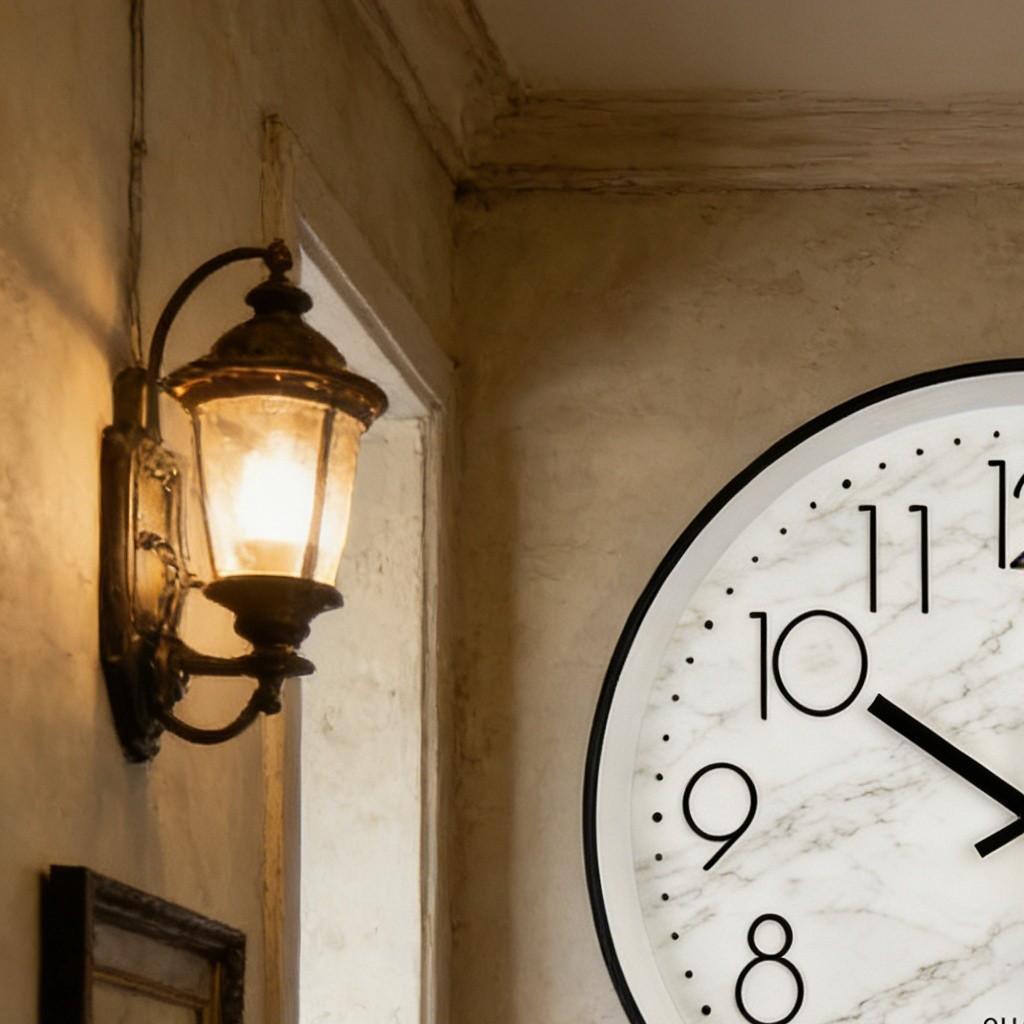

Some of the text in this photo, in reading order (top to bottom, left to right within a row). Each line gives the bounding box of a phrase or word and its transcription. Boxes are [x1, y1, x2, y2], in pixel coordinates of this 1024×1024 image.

[857, 504, 929, 615] 11
[749, 609, 869, 721] 10
[682, 762, 758, 872] 9
